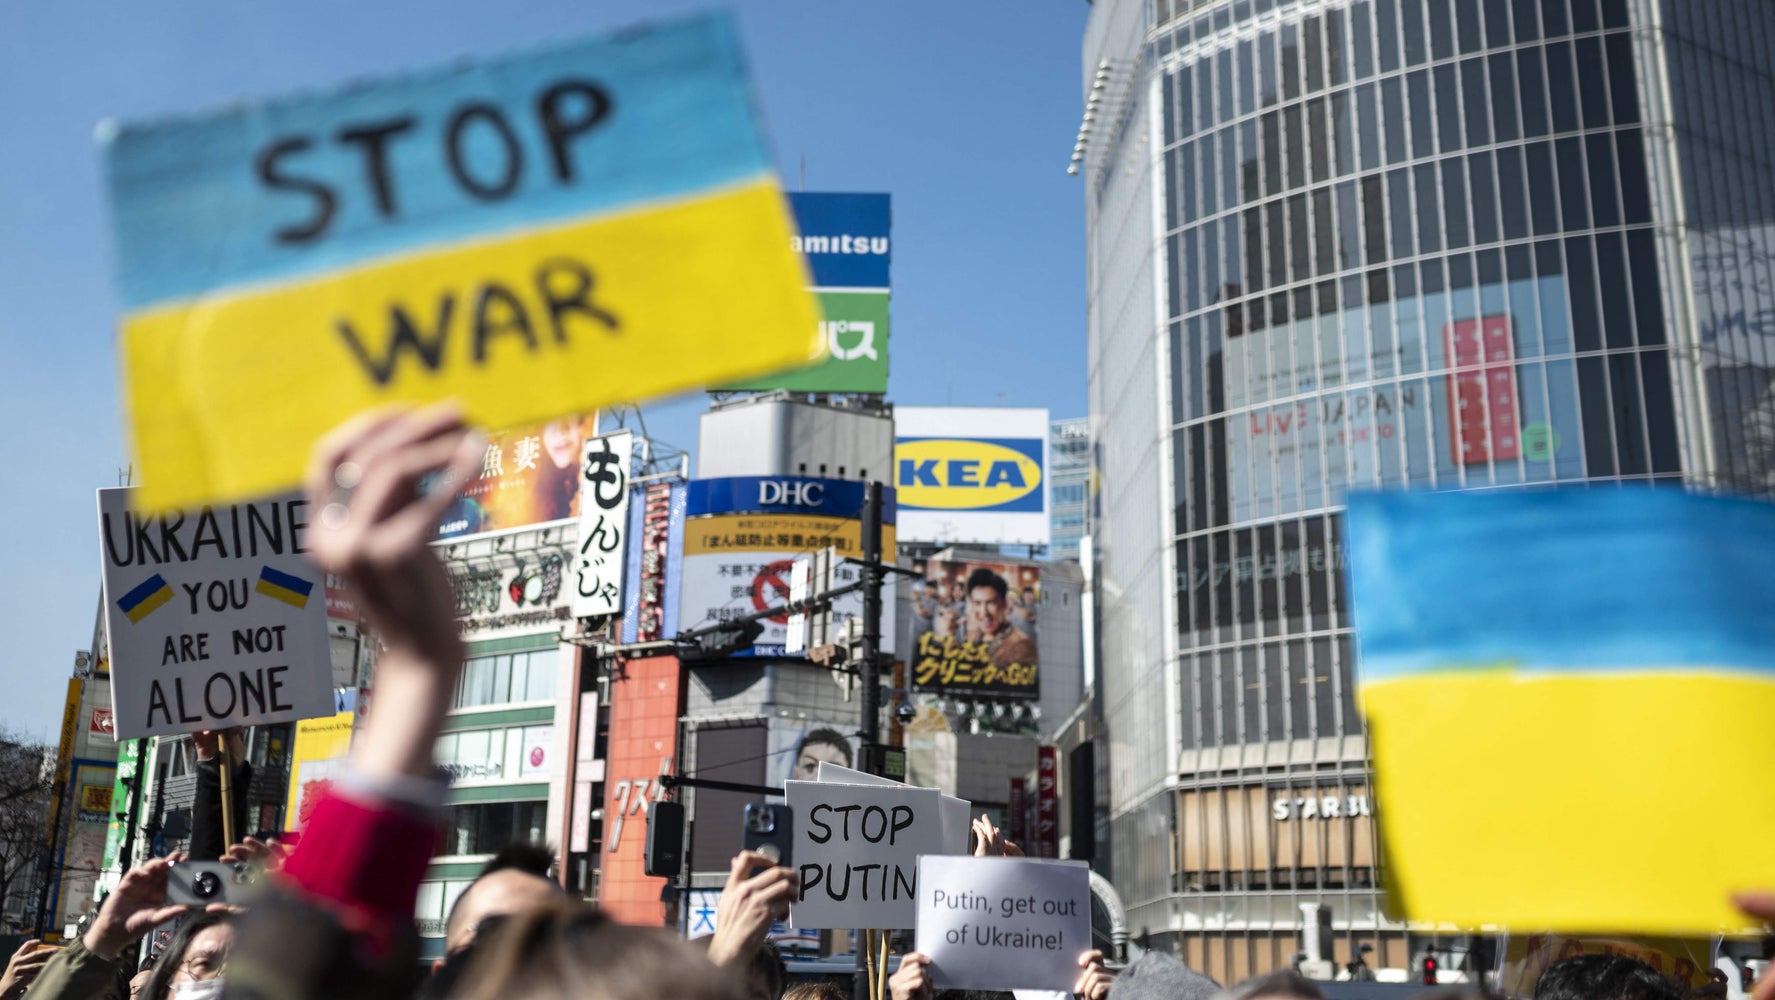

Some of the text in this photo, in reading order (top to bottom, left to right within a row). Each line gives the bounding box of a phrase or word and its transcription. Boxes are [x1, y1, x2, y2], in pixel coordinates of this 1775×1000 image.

[254, 77, 617, 246] STOP
[334, 257, 623, 388] WAR
[1250, 387, 1416, 437] LIVE JAPAN
[758, 480, 824, 507] DHC
[899, 459, 1028, 488] KEA
[103, 499, 313, 568] UKRAINE
[577, 437, 625, 608] もんじゃ
[182, 578, 248, 614] YOU
[161, 625, 286, 666] ARE NOT
[146, 666, 293, 728] ALONE
[808, 803, 914, 846] STOP
[799, 863, 917, 902] PUTIN
[933, 889, 1078, 918] Putin, get out
[945, 924, 1064, 950] of Ukraine!
